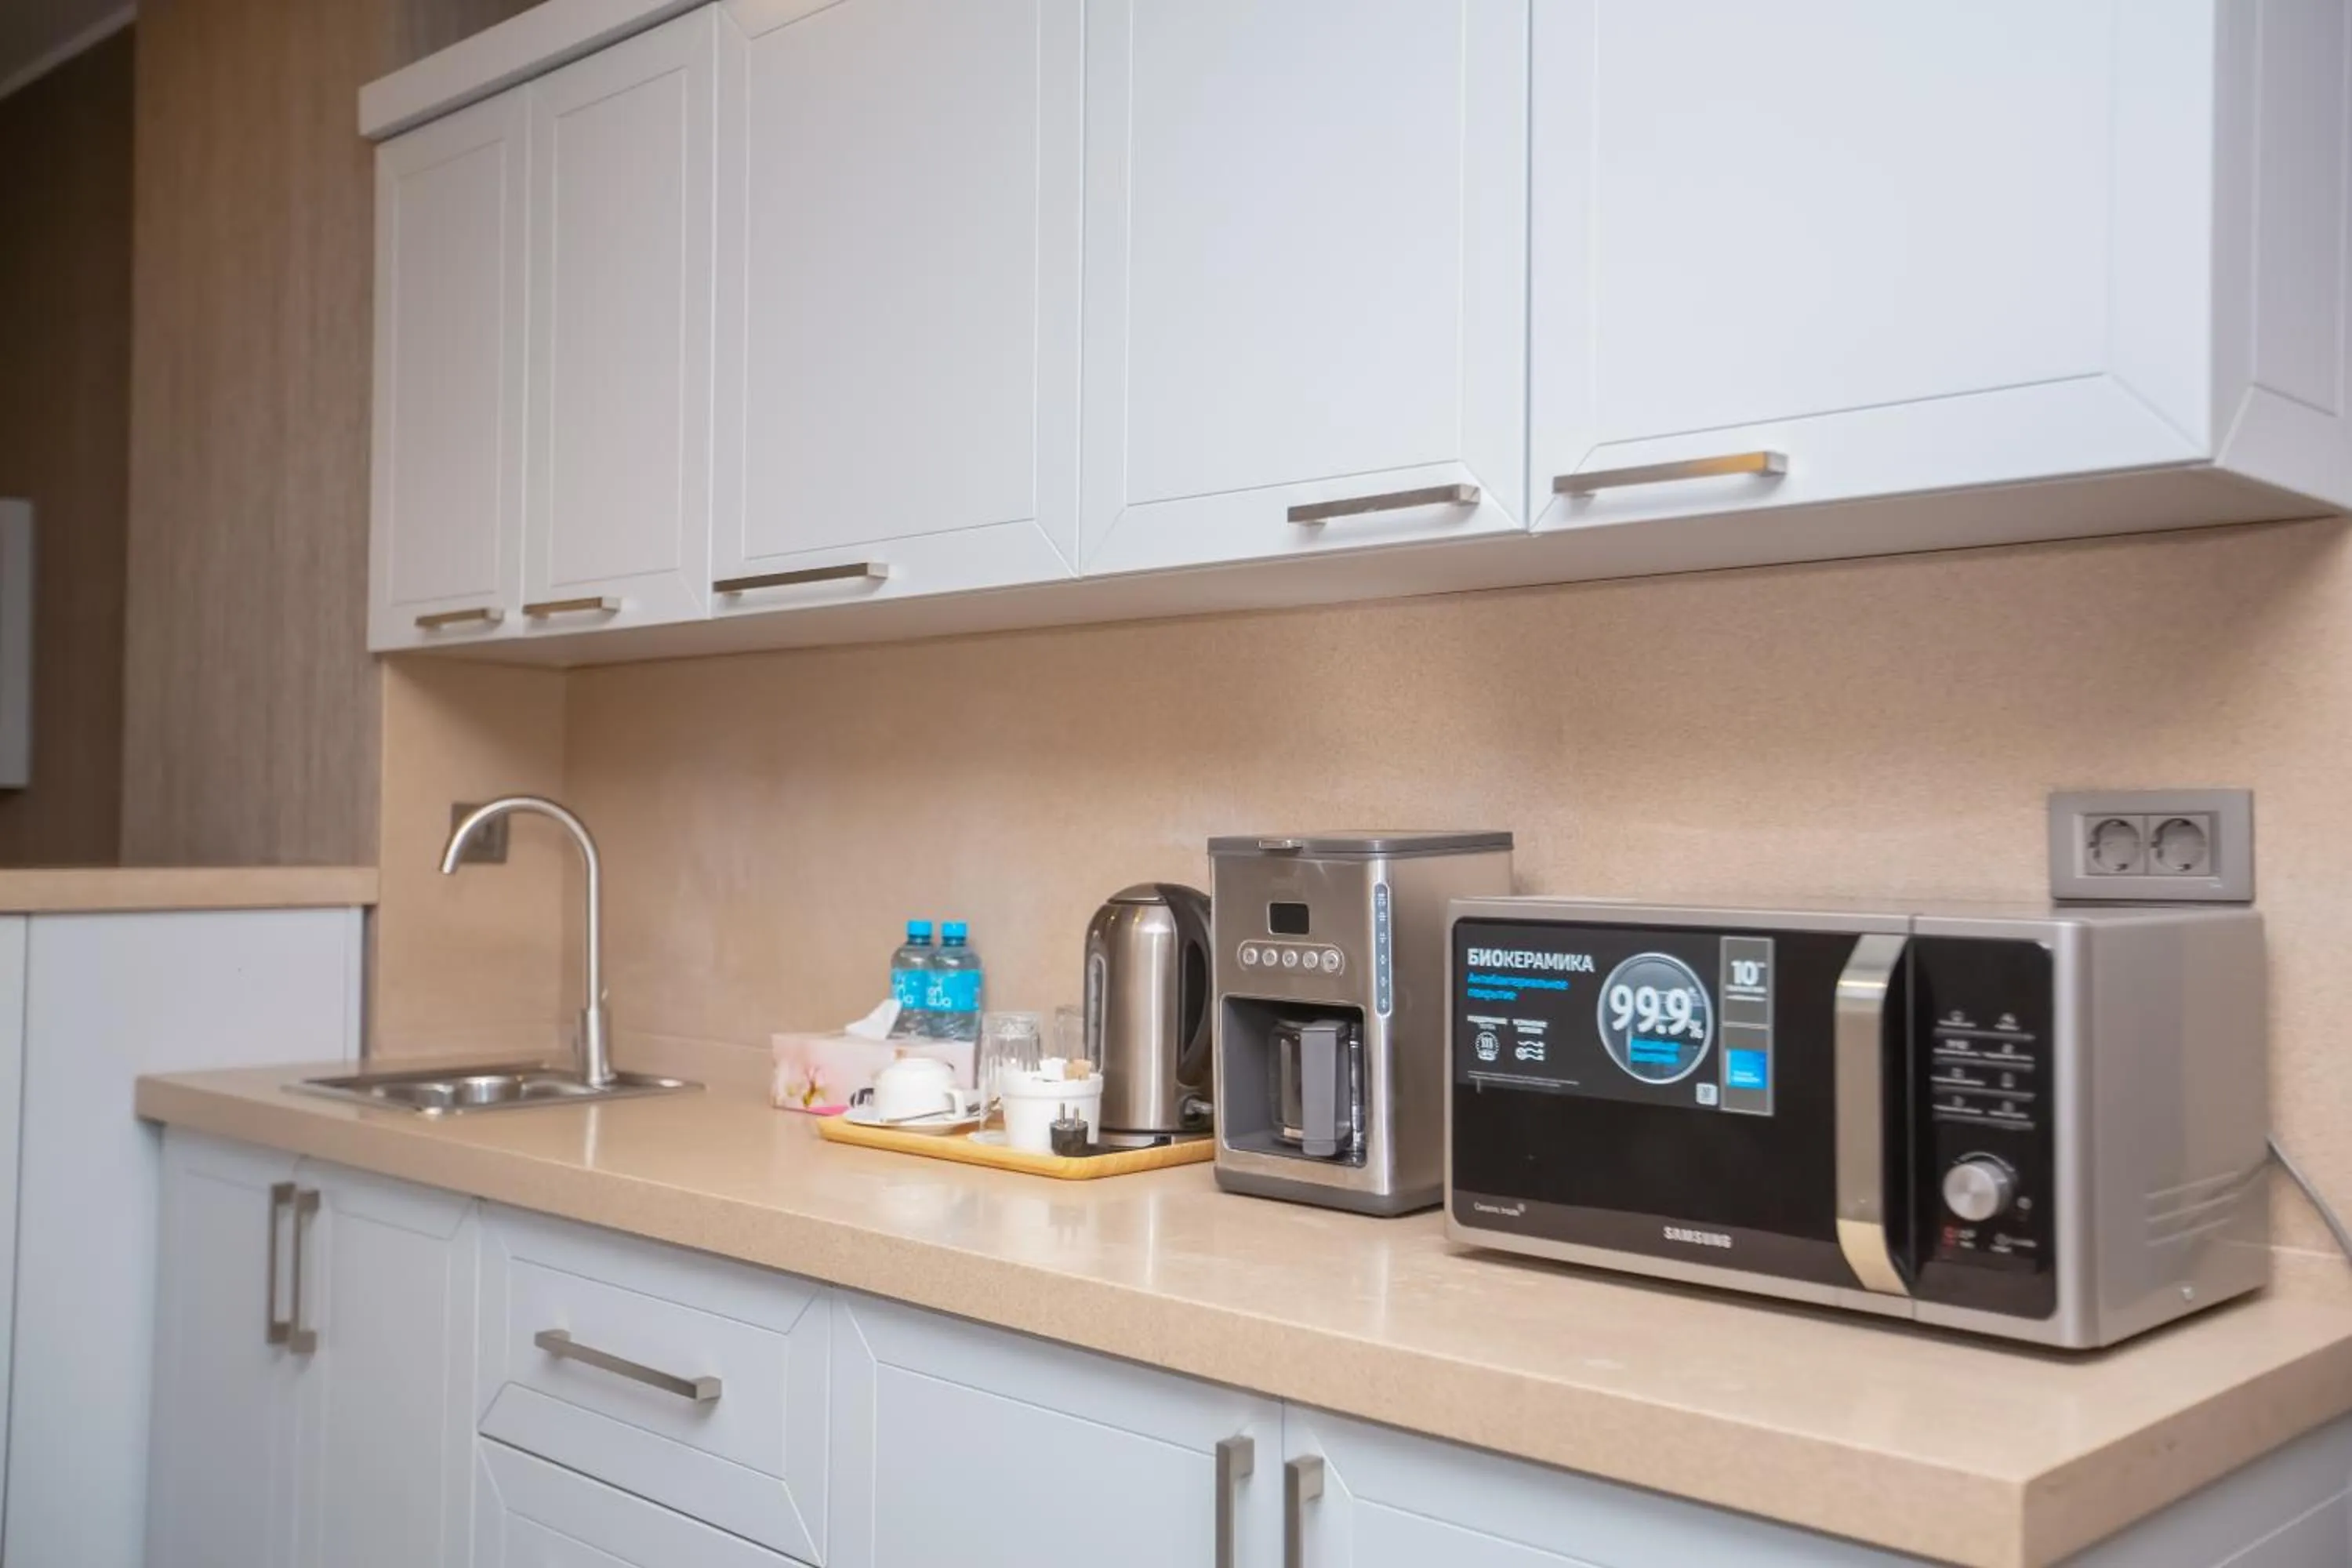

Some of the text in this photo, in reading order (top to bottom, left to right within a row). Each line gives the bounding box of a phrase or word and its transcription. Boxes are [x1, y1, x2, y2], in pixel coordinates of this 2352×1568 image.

[1467, 947, 1595, 973] БИОКЕРАМИКА
[1730, 960, 1759, 985] 10
[1663, 1225, 1732, 1249] SAMSUNG
